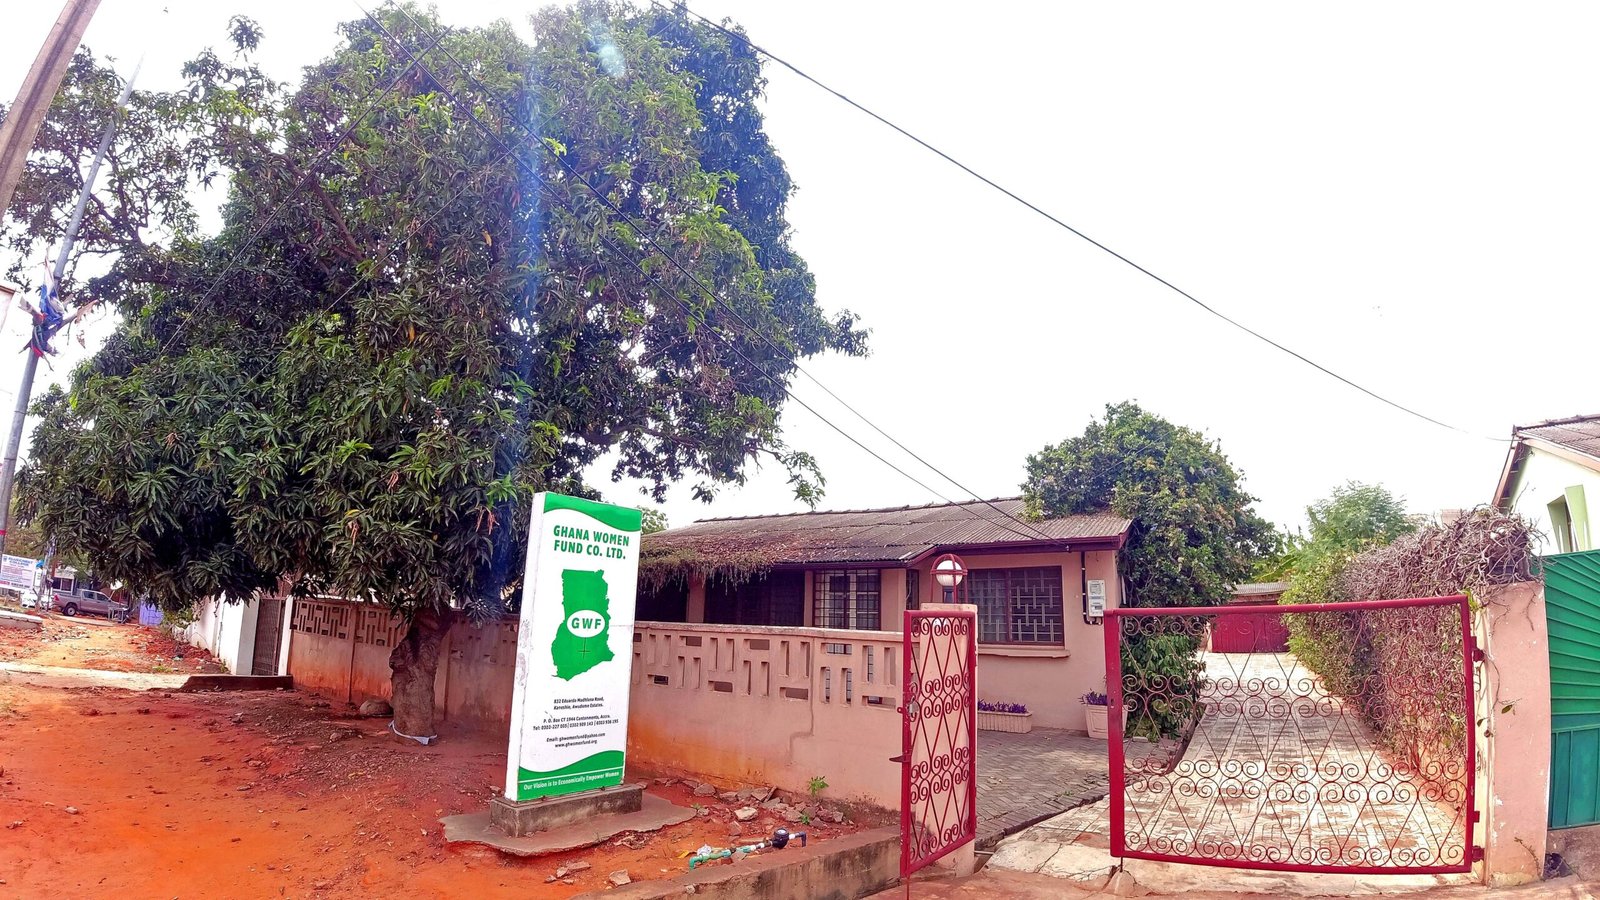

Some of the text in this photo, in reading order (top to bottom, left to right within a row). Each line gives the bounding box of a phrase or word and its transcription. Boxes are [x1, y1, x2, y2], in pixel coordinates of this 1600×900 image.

[553, 525, 630, 546] GHANA WOMEN
[553, 540, 626, 560] FUND CO. LTD.
[571, 617, 602, 629] GWF
[558, 776, 586, 786] Economically
[586, 774, 605, 782] Empower
